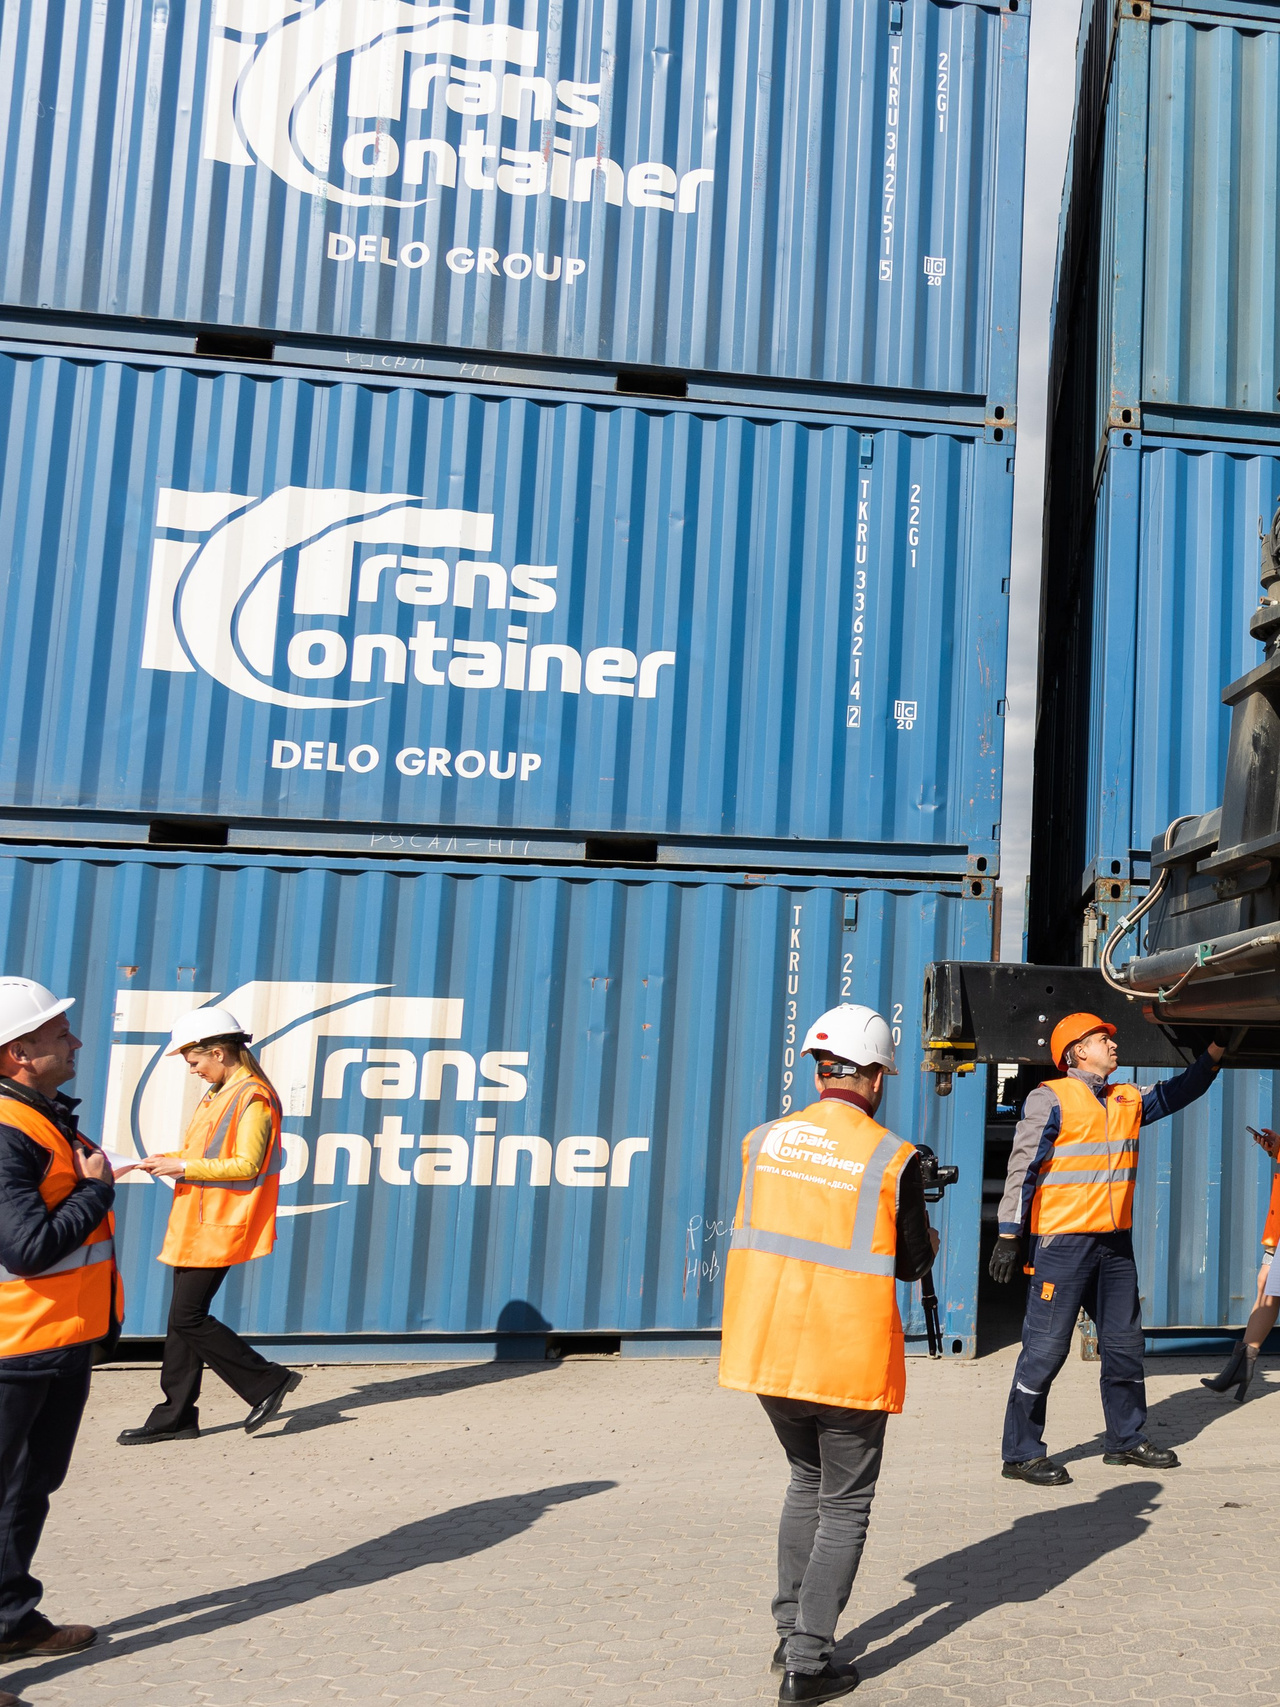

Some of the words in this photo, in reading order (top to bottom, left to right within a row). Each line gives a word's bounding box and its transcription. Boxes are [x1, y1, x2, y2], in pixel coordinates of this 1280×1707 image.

[888, 46, 900, 126] TKRU
[937, 52, 948, 132] 22G1
[883, 132, 897, 255] 342751
[327, 231, 431, 269] DELO
[445, 246, 587, 285] GROUP
[927, 275, 941, 286] 20
[857, 480, 870, 564] TKRU
[909, 484, 921, 568] 22G1
[850, 570, 866, 700] 336214
[271, 740, 380, 774] DELO
[395, 746, 542, 781] GROUP
[896, 719, 913, 730] 20
[788, 905, 802, 995] TKRU
[782, 1001, 798, 1115] 33099
[781, 1169, 826, 1185] КОМПАНИИ
